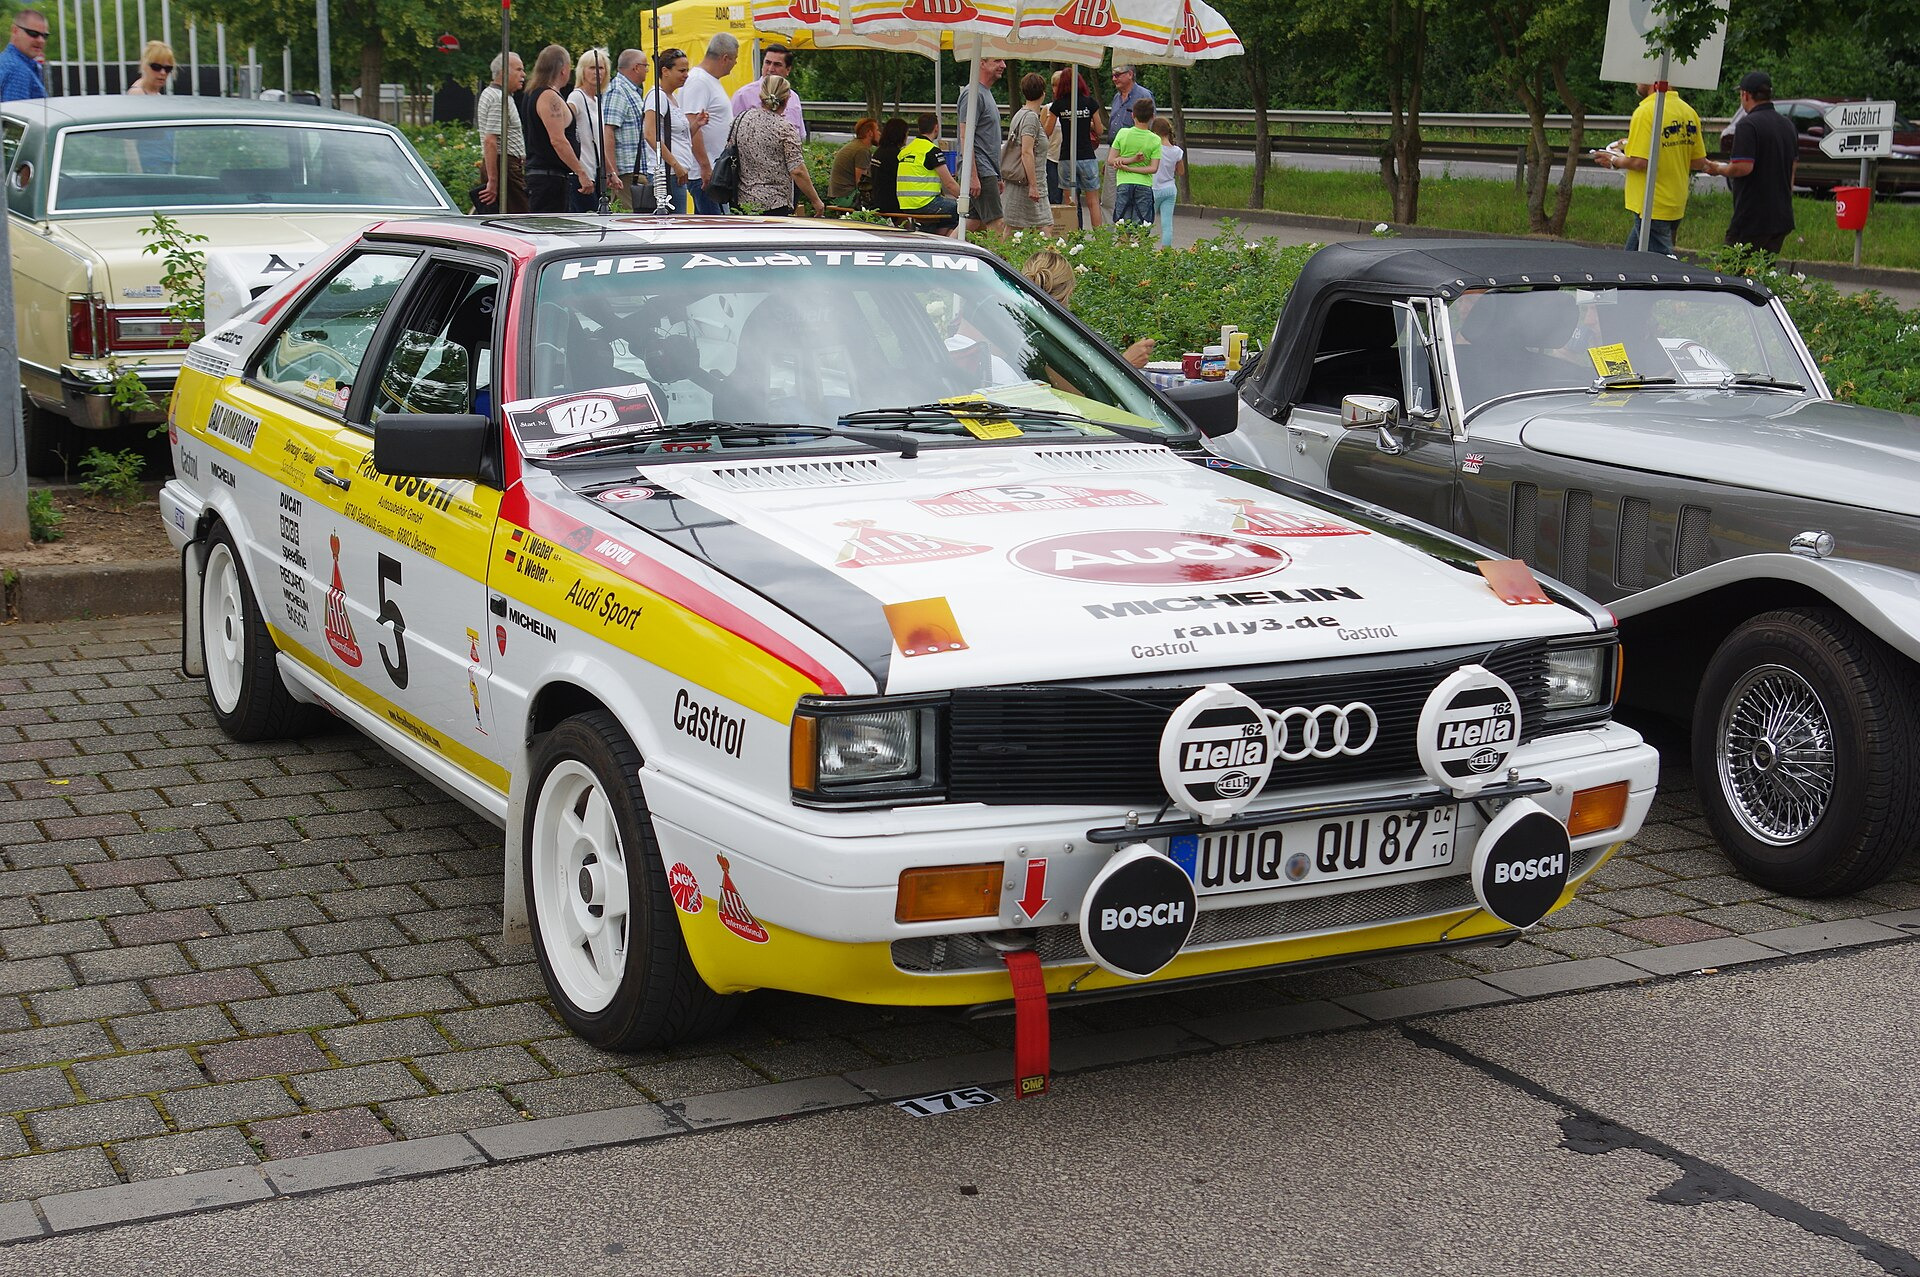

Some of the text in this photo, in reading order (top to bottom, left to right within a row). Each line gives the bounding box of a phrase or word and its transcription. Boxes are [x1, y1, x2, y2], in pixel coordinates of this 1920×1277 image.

[715, 6, 730, 20] ADAC
[1073, 0, 1111, 29] HB
[1182, 10, 1200, 44] HB
[1840, 106, 1882, 126] Ausfahrt
[561, 250, 980, 281] HB Audi TEAM
[207, 402, 224, 432] BAD
[560, 402, 609, 429] 175
[180, 445, 199, 482] Castrol
[210, 461, 236, 489] MICHELIN
[279, 491, 302, 518] DUCATI
[922, 493, 1152, 517] RALLYE MONTE CARLO
[996, 486, 1046, 501] 5
[279, 513, 300, 547] BOGE
[355, 508, 377, 533] Saarlouis
[406, 508, 425, 526] GmbH
[1234, 512, 1326, 529] HB
[846, 532, 943, 556] HB
[1250, 526, 1357, 536] international
[282, 544, 307, 571] speedline
[528, 536, 554, 562] Weber
[594, 539, 636, 567] MOTUL
[855, 546, 977, 566] international
[279, 564, 306, 595] RECARO
[516, 555, 523, 574] B.
[523, 558, 549, 584] Weber
[282, 586, 310, 613] MICHELIN
[327, 585, 351, 640] HB
[564, 578, 643, 631] Audi Sport
[1082, 586, 1366, 620] MICHELIN
[285, 603, 309, 632] BOSCH
[376, 550, 410, 691] 5
[508, 606, 557, 644] MICHELIN
[1173, 613, 1341, 640] rally3.de
[1336, 624, 1399, 642] Castrol
[329, 636, 359, 662] international
[1130, 640, 1199, 659] Castrol
[1492, 702, 1513, 717] 162
[673, 687, 747, 760] Castrol
[1241, 723, 1264, 738] 162
[1440, 718, 1513, 749] Hella
[1184, 738, 1265, 771] Hella
[1470, 751, 1500, 765] HELLA
[1218, 776, 1251, 789] HELLA
[1433, 807, 1452, 824] 04
[1316, 818, 1371, 874] QU
[1379, 810, 1429, 866] 87
[1432, 841, 1448, 859] 10
[673, 872, 696, 888] NGK
[1494, 852, 1565, 885] BOSCH
[720, 885, 753, 926] HB
[1100, 901, 1186, 932] BOSCH
[724, 915, 764, 940] international
[1022, 1077, 1045, 1091] OMP
[899, 1088, 996, 1116] 175
